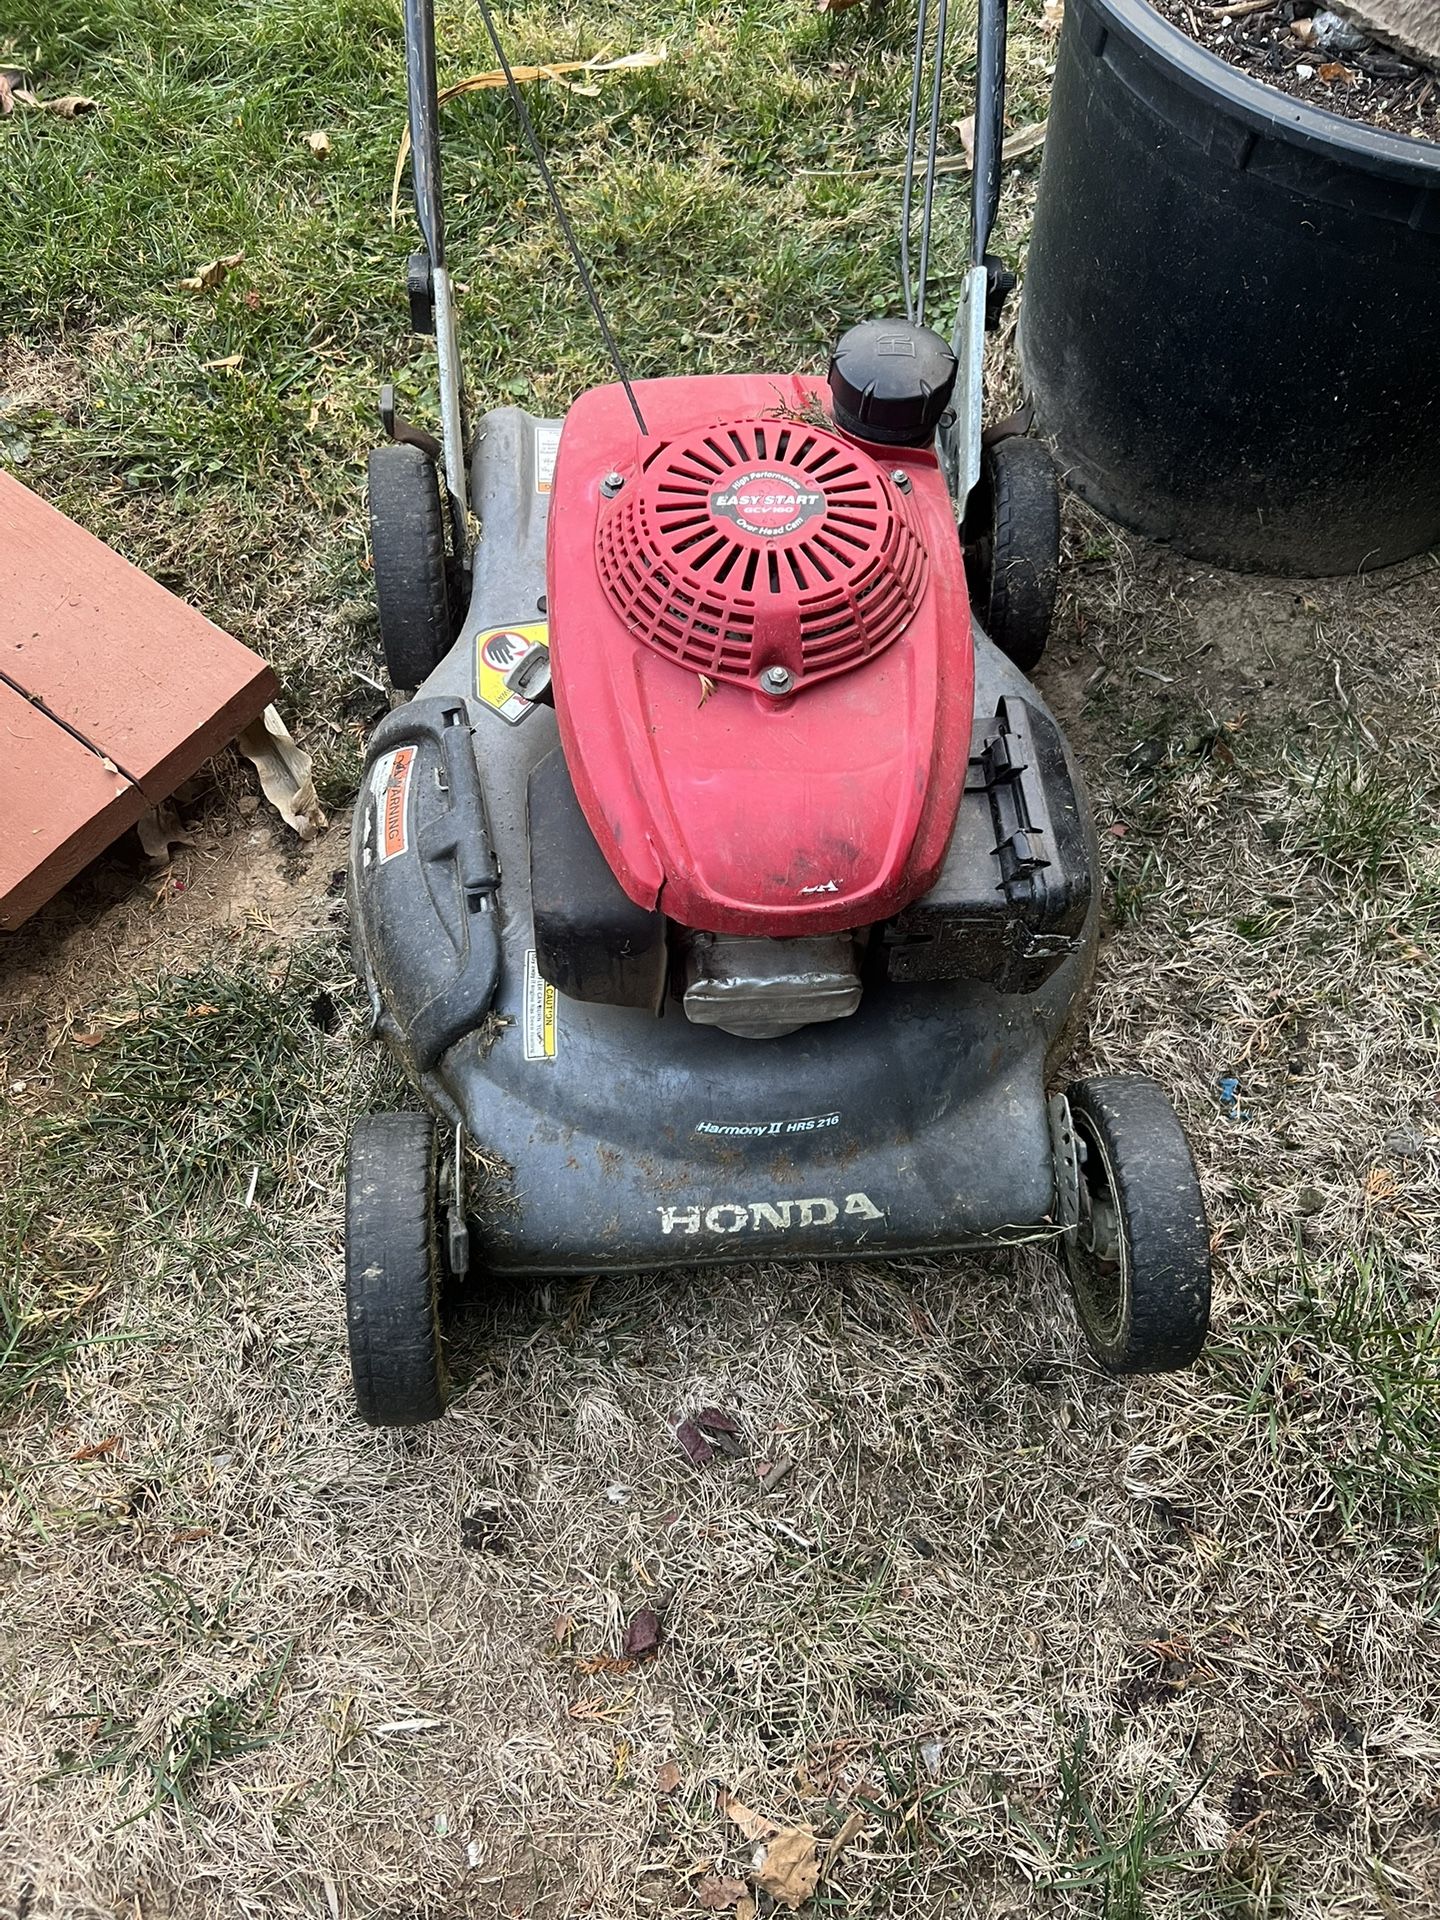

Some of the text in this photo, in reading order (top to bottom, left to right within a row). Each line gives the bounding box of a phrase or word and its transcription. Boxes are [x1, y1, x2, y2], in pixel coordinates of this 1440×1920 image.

[732, 472, 801, 490] High Performance
[716, 495, 819, 505] EASY START
[736, 518, 804, 535] Over Head Cam
[697, 1122, 767, 1136] Harmony
[786, 1121, 815, 1132] HRS
[817, 1116, 840, 1128] 216
[656, 1193, 885, 1234] HONDA
